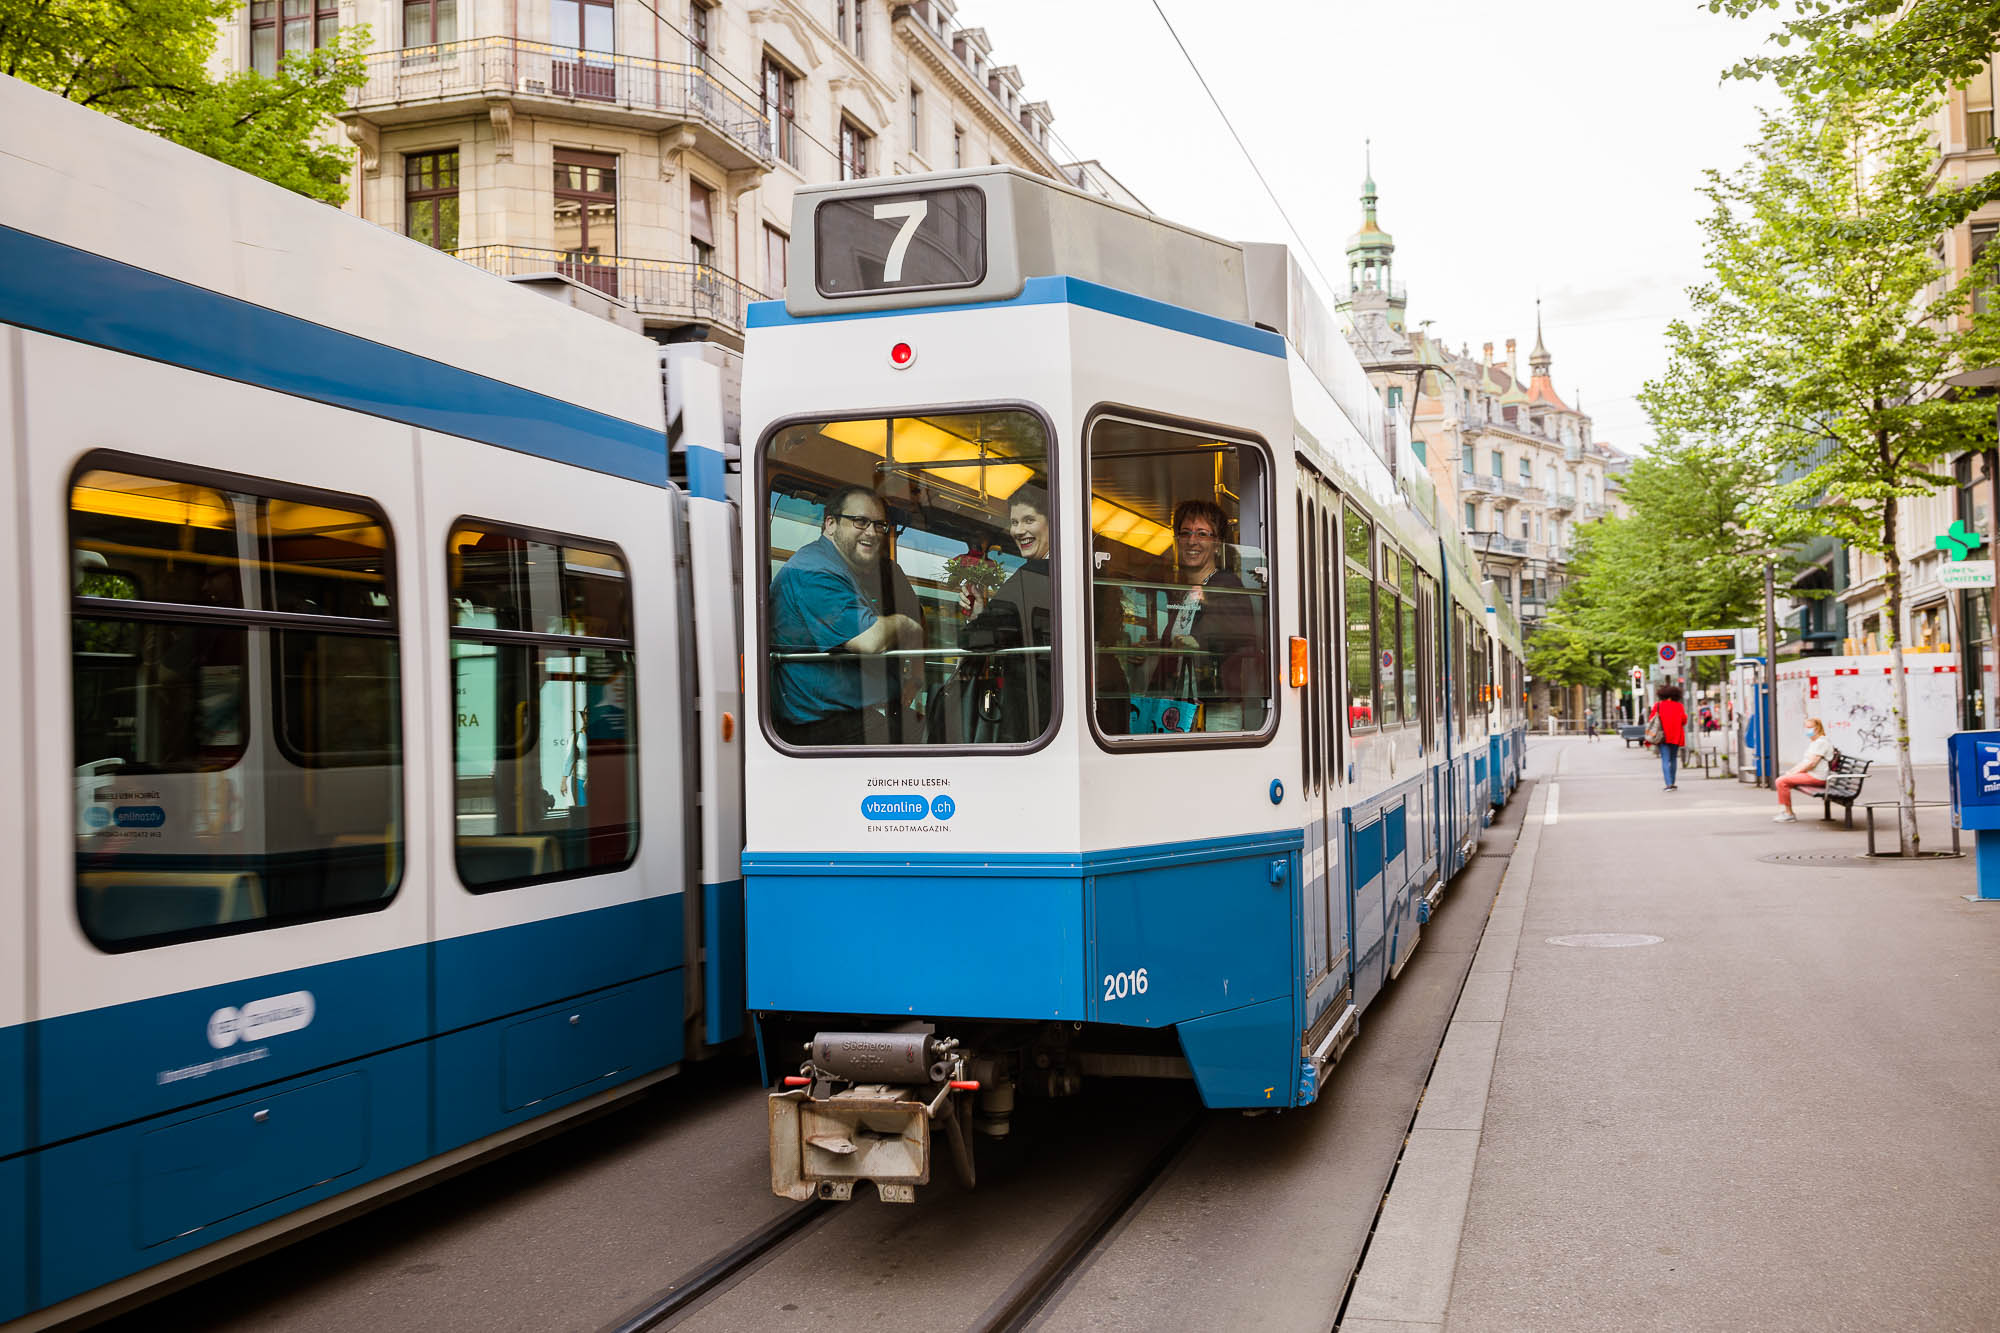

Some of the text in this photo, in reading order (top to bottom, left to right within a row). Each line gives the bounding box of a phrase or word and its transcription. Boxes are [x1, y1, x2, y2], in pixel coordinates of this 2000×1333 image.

[873, 199, 928, 283] 7
[867, 777, 951, 787] ZÜRICH NEU LESEN:
[866, 801, 923, 813] vbzonline
[1103, 967, 1149, 1002] 2016
